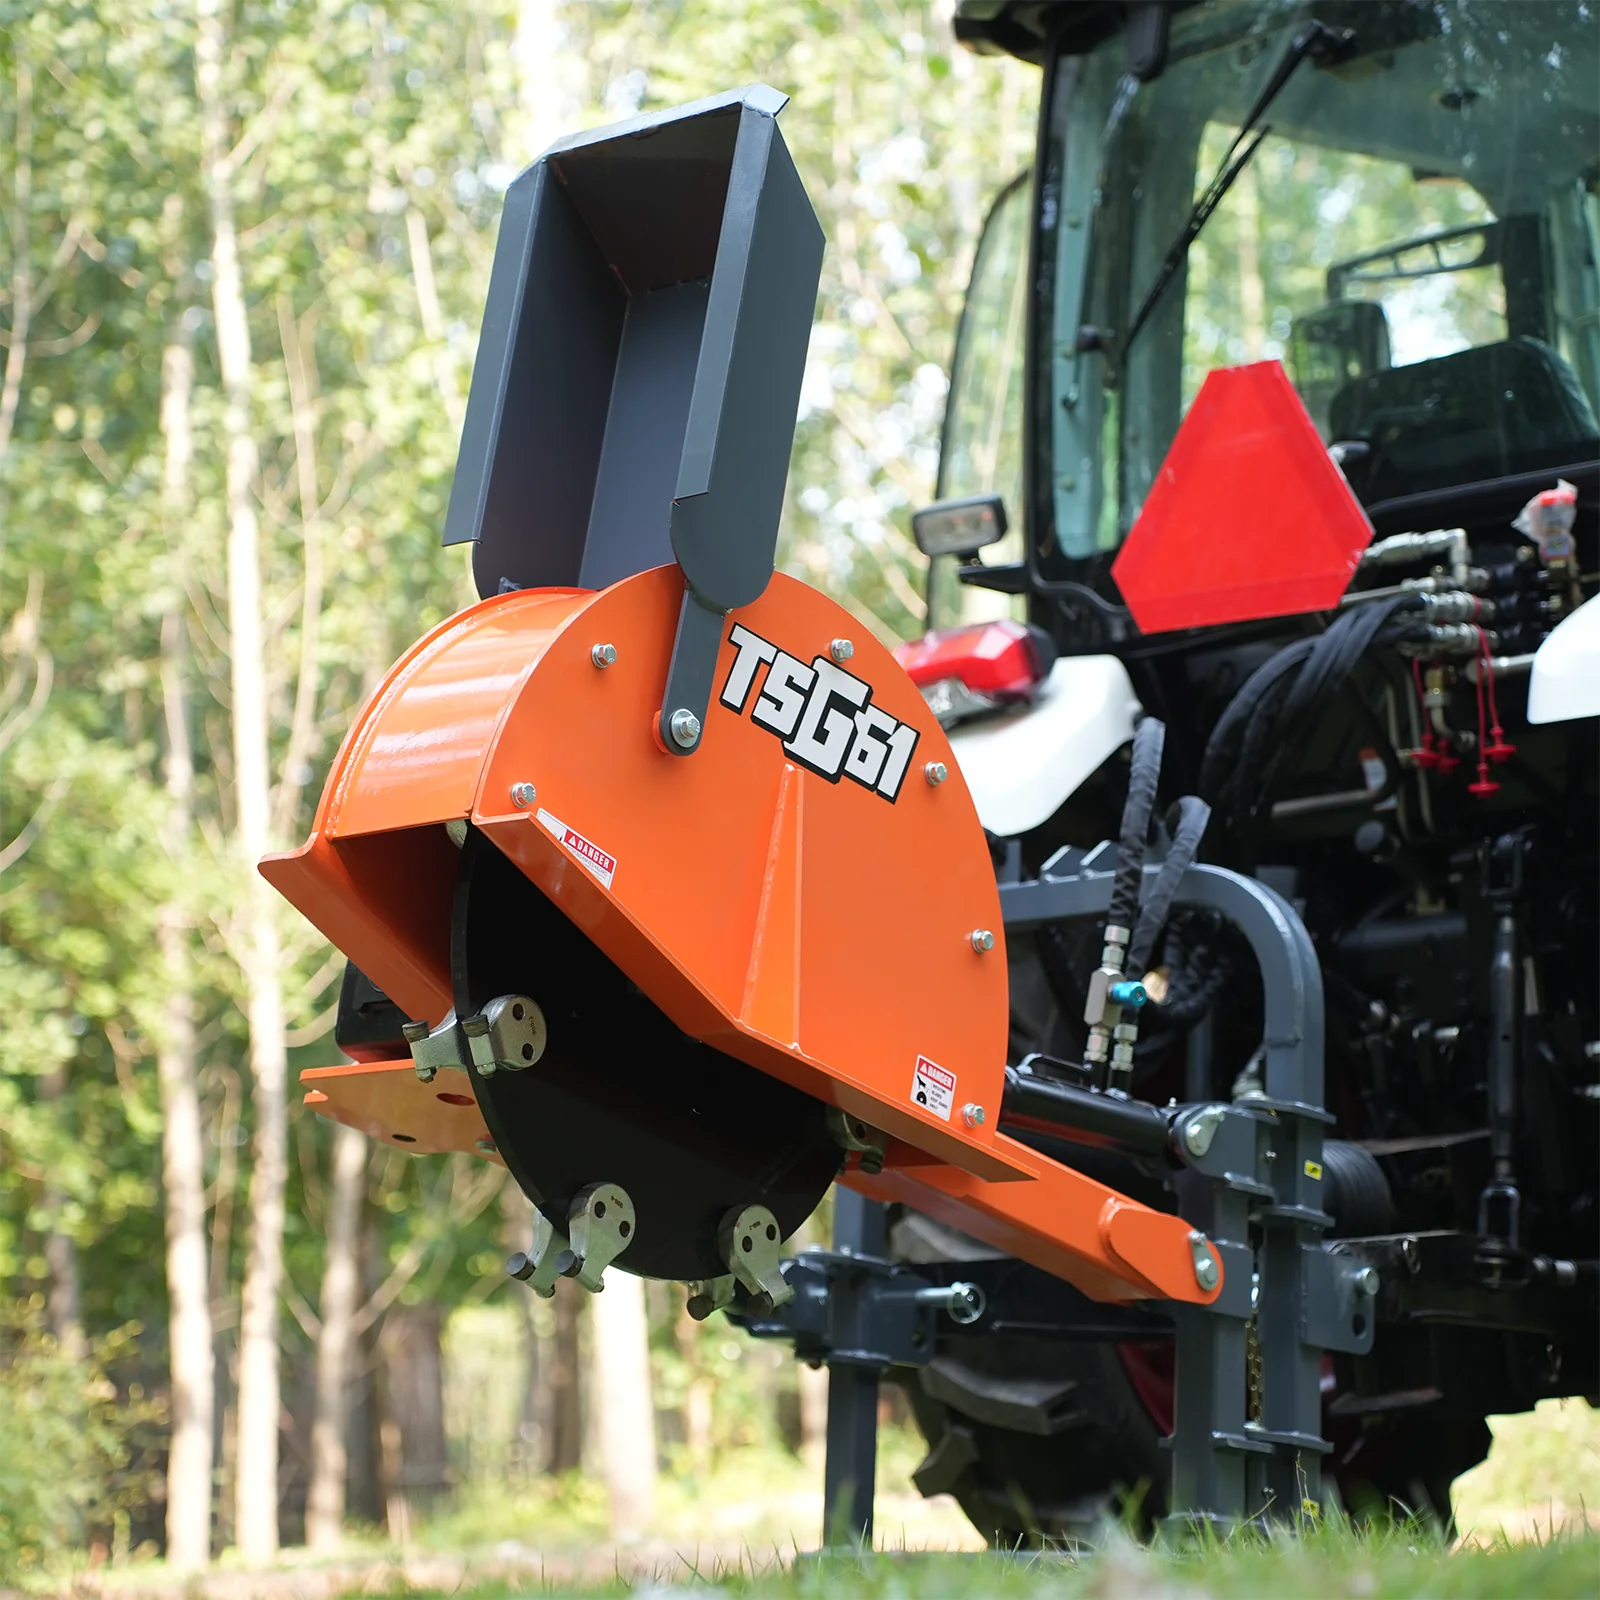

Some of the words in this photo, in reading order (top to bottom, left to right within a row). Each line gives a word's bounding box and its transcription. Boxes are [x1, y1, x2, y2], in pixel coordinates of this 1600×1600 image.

[719, 622, 920, 805] TSG61
[577, 839, 609, 869] DANGER
[927, 1065, 953, 1088] DANGER
